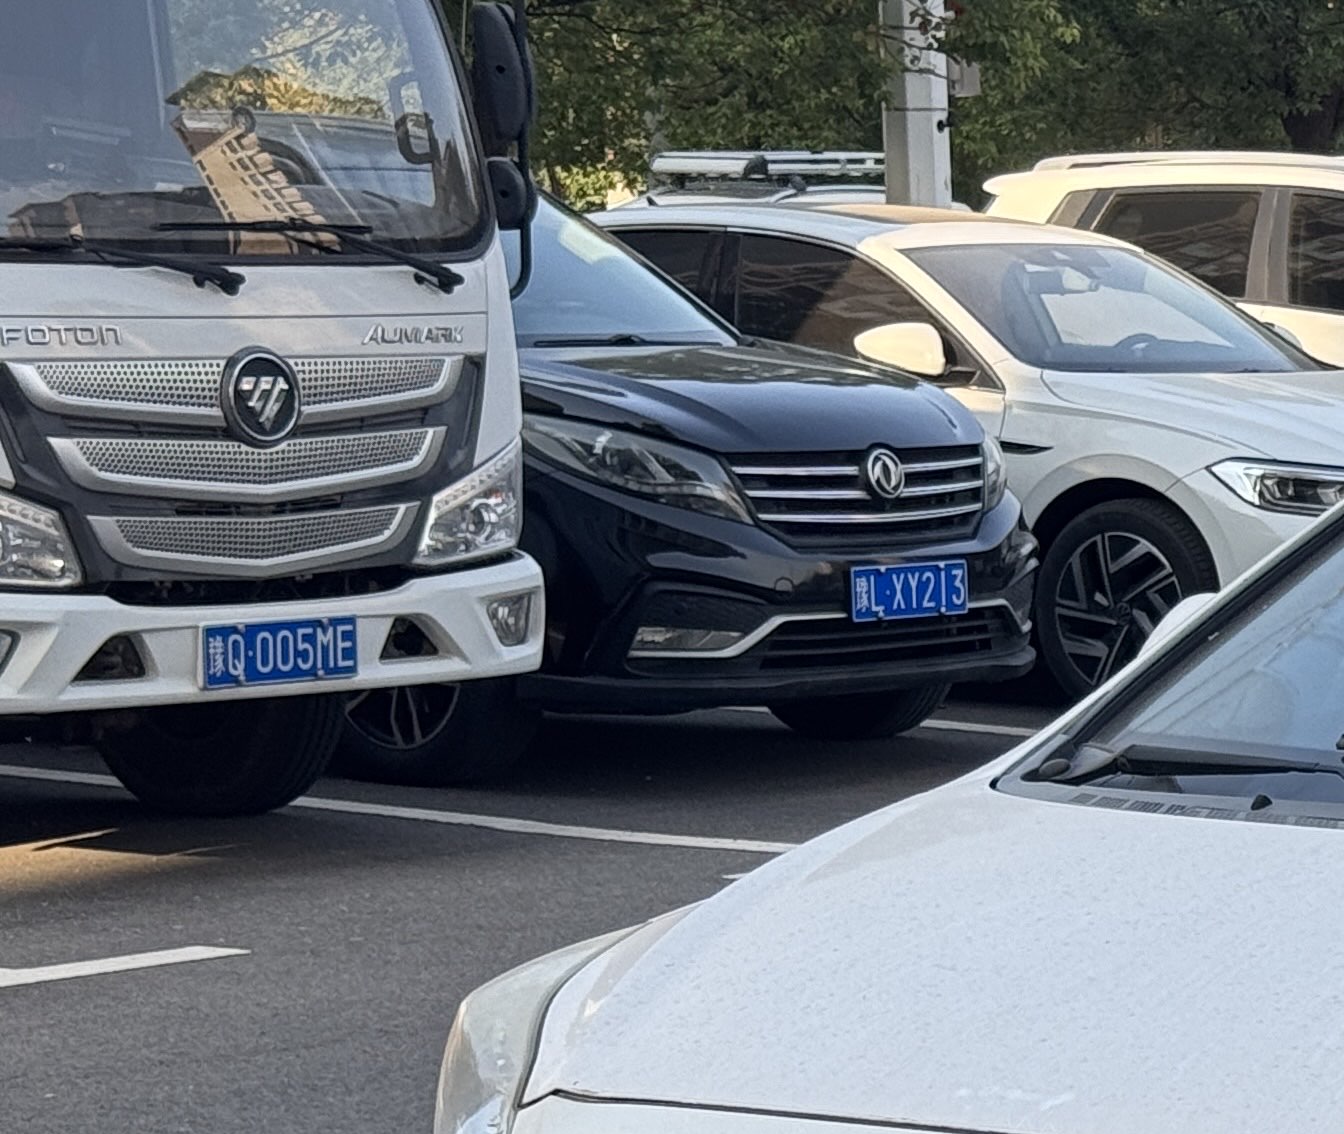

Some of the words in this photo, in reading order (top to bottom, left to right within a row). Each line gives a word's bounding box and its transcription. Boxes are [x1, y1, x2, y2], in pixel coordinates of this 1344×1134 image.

[1, 325, 122, 346] FOTON
[361, 324, 464, 345] AUMARK
[855, 568, 965, 613] 豫L·XY213
[208, 624, 355, 678] 豫Q·005ME
